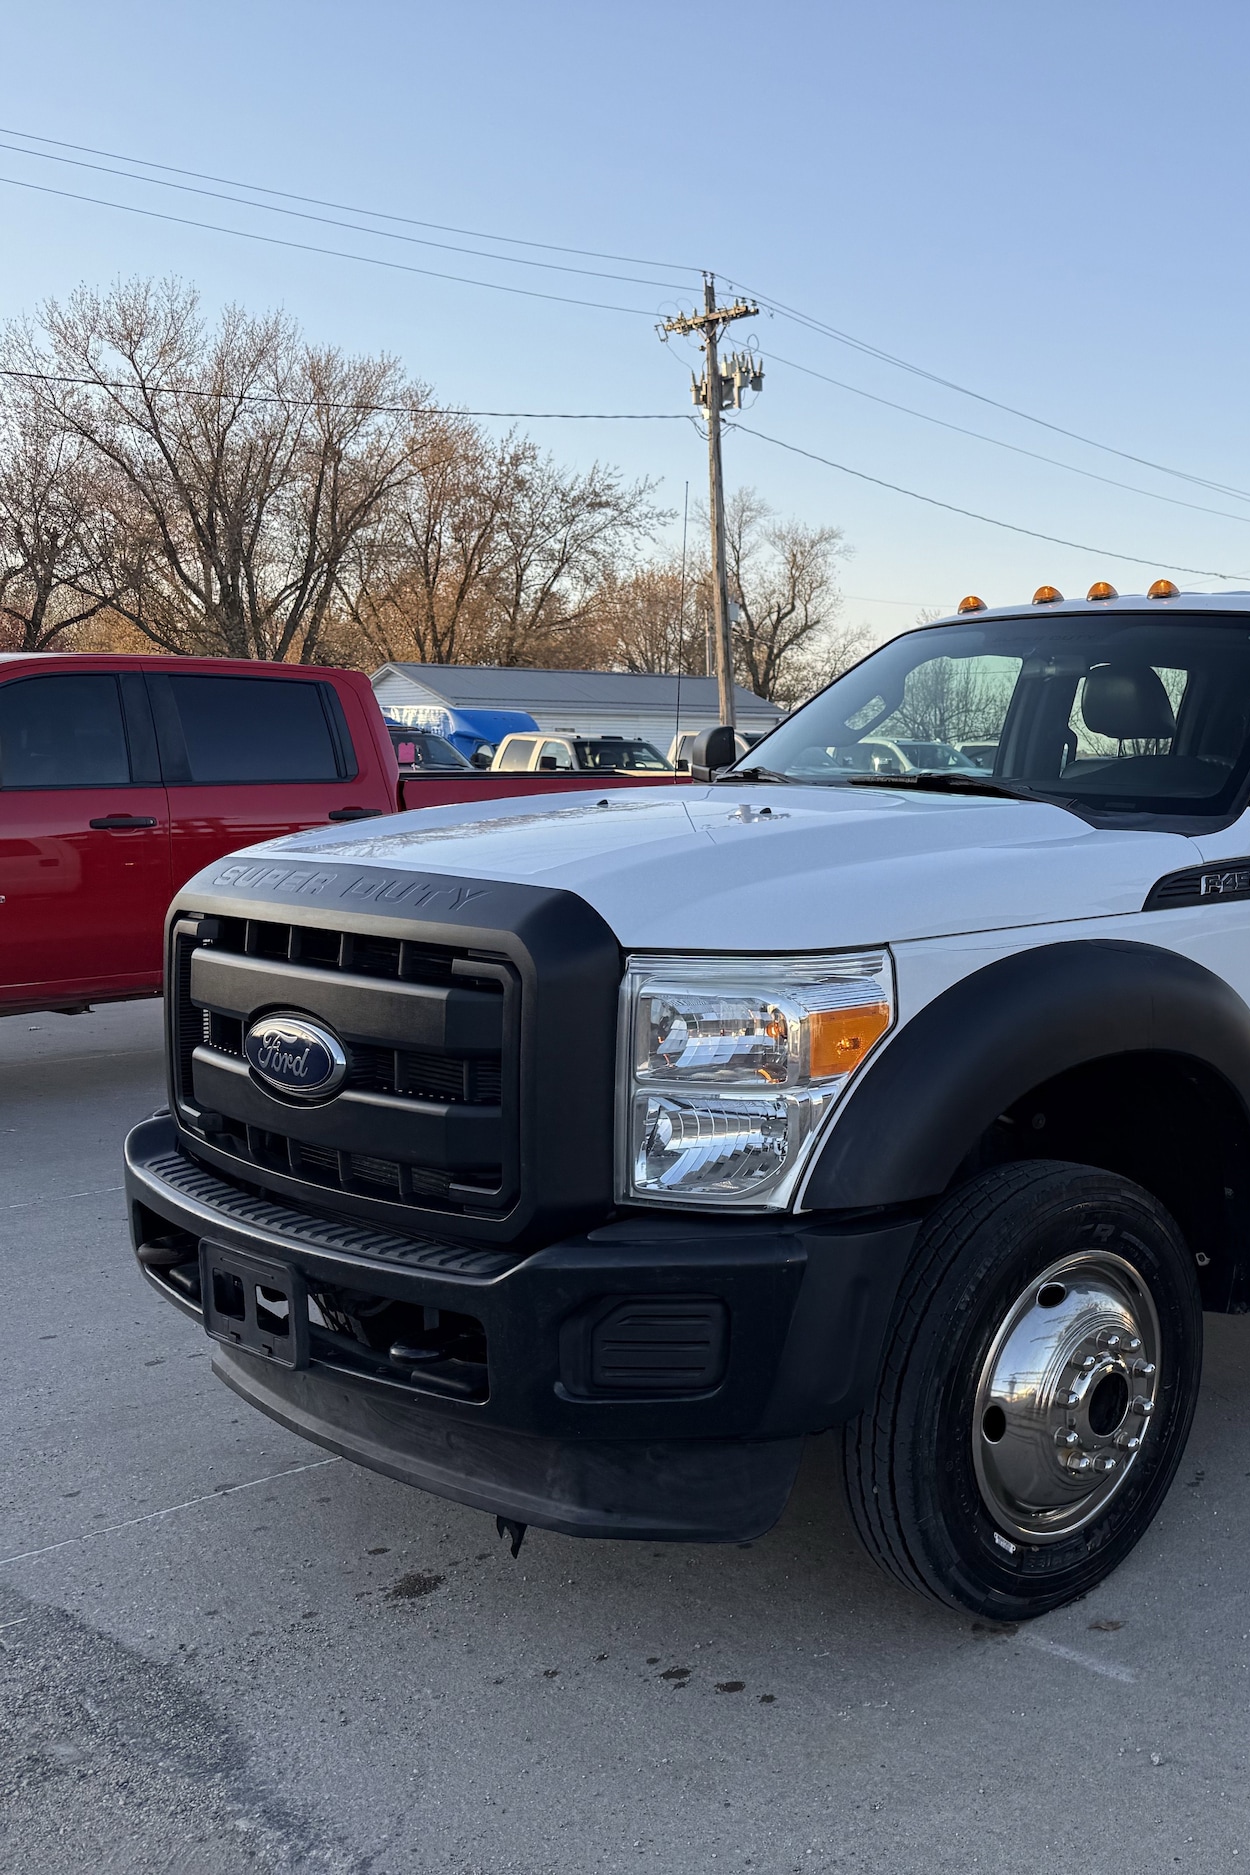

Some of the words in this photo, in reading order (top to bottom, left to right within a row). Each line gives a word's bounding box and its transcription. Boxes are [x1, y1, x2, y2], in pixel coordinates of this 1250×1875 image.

[212, 865, 339, 895] SUPER
[340, 875, 494, 911] DUTY
[258, 1029, 310, 1078] Ford
